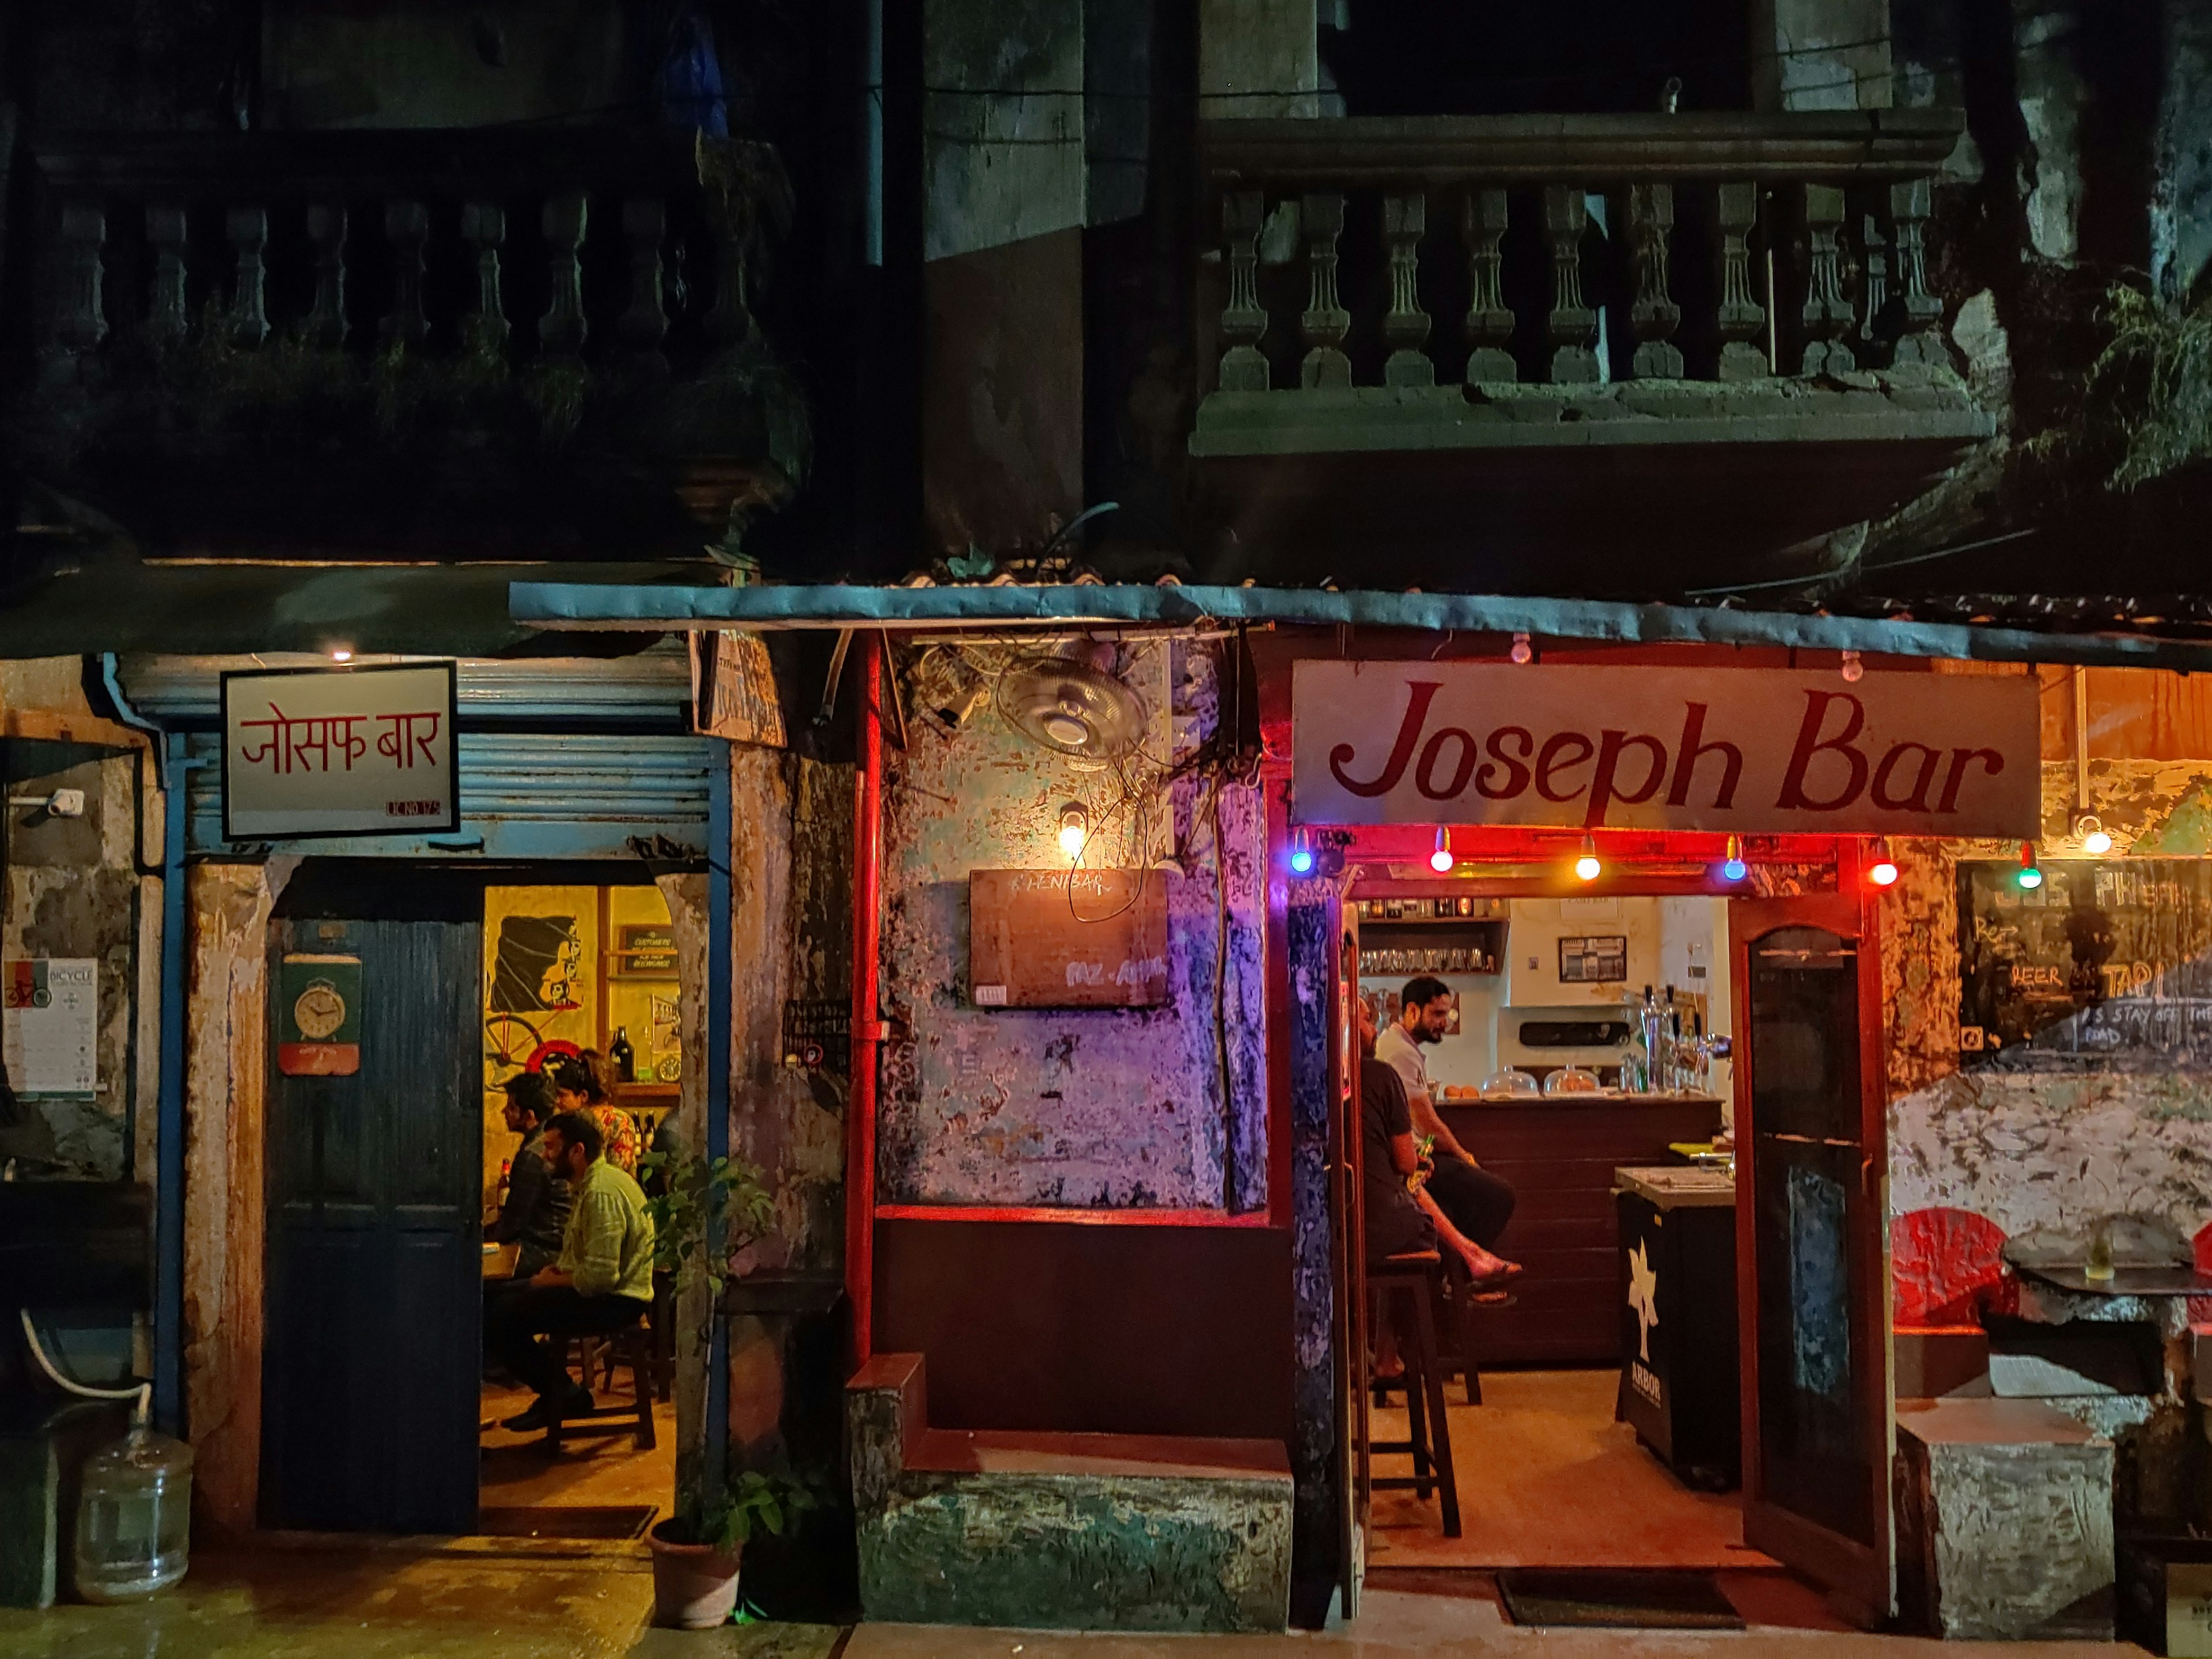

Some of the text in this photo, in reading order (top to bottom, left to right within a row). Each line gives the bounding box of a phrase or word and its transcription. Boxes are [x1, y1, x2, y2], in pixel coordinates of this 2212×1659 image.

[240, 702, 441, 774] जोसफ बार
[1330, 680, 2005, 827] Joseph Bar
[2112, 1005, 2152, 1025] STAY
[1632, 1361, 1661, 1402] ARBOR
